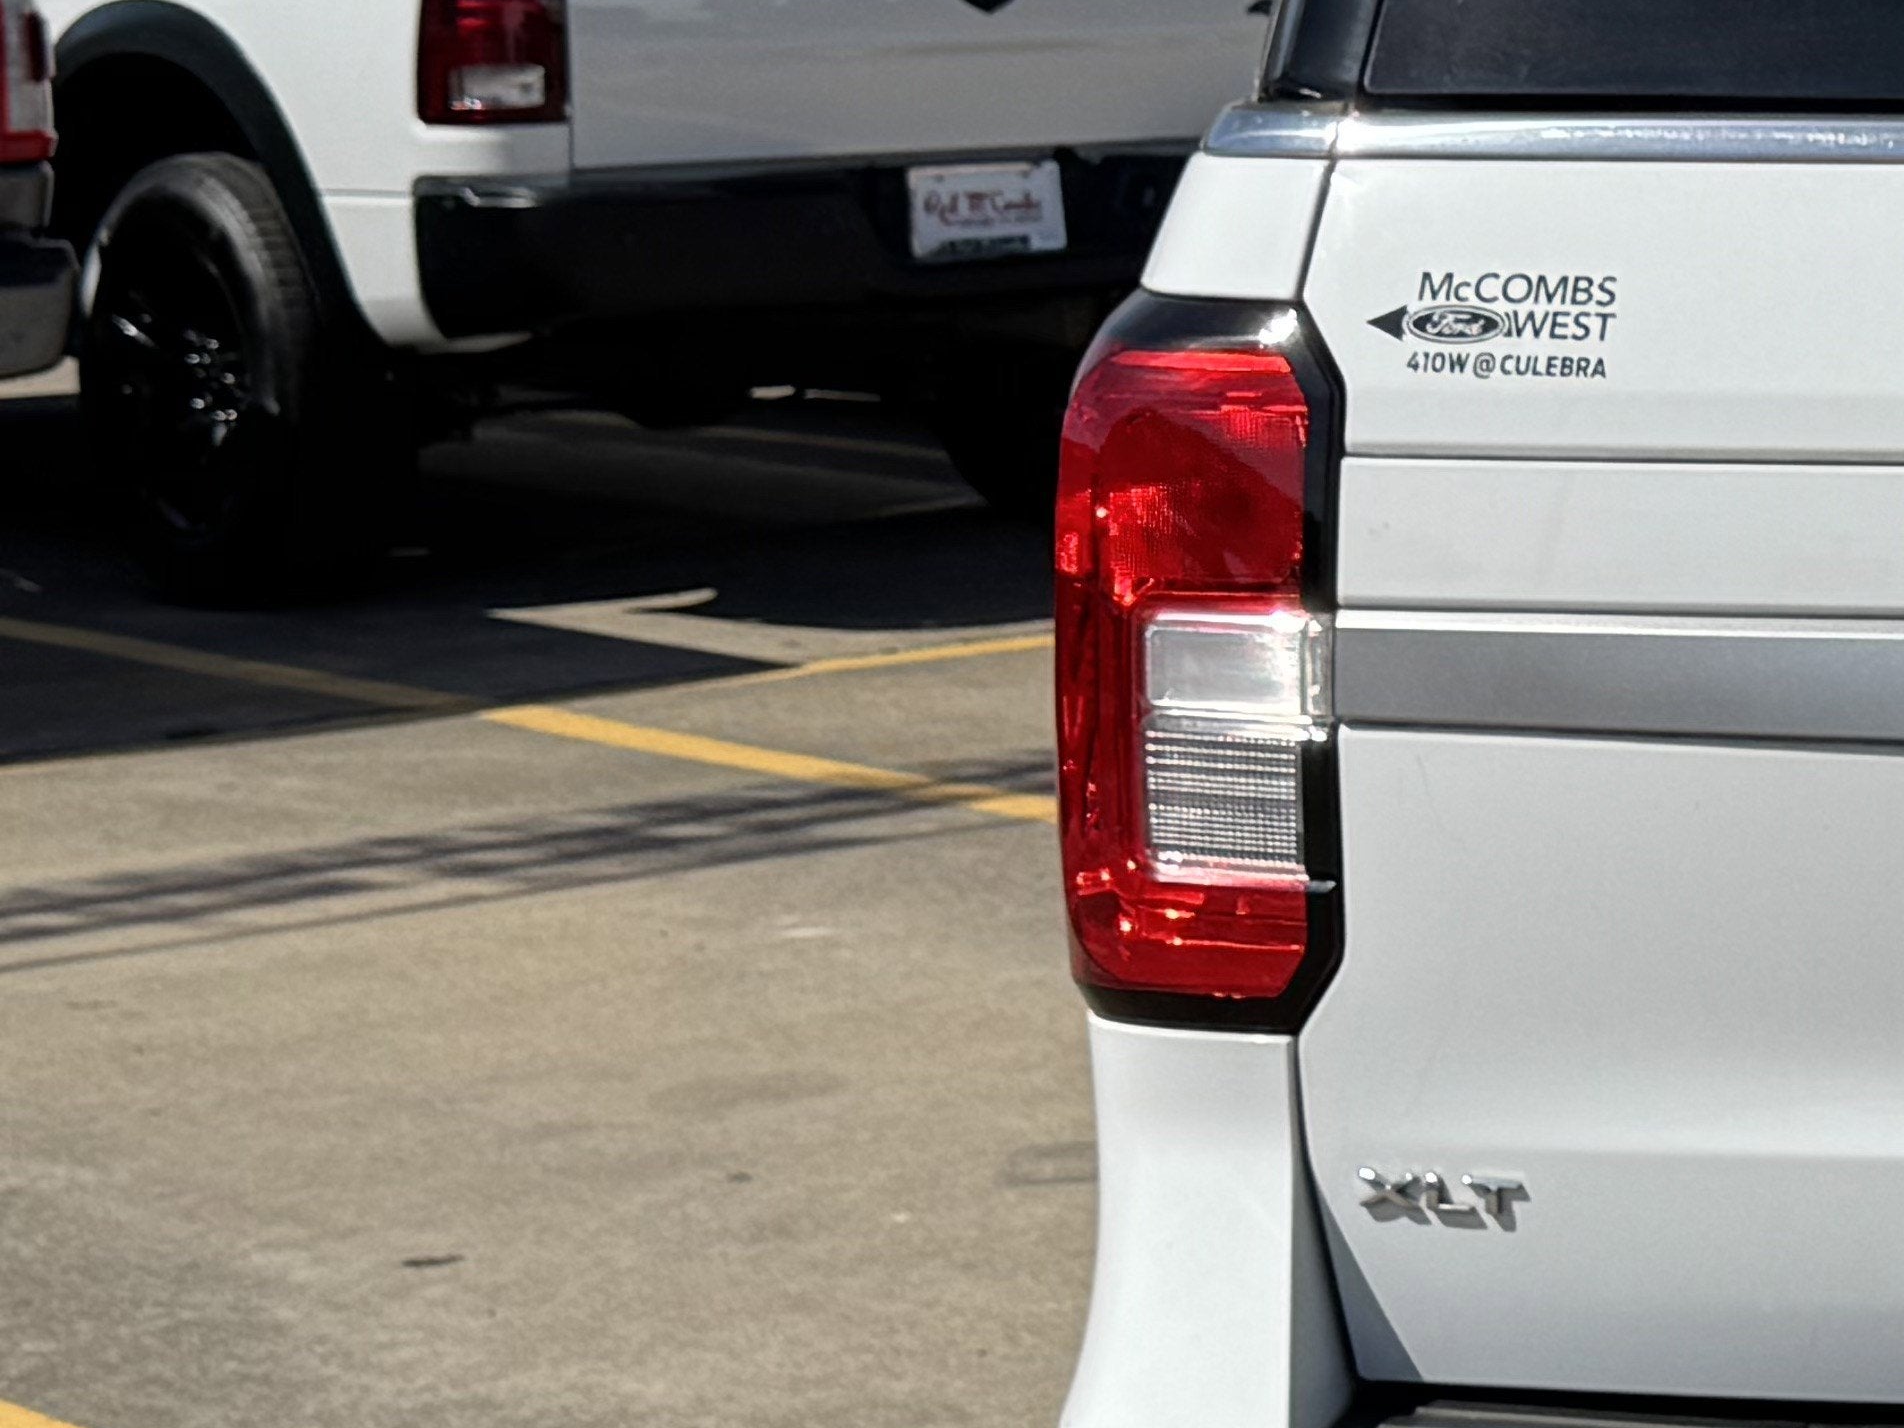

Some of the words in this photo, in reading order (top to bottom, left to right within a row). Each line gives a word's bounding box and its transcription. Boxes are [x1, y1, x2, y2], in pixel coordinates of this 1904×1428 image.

[1417, 271, 1618, 307] McCOMBS
[1511, 310, 1617, 341] WEST
[1358, 1167, 1528, 1222] XLT
